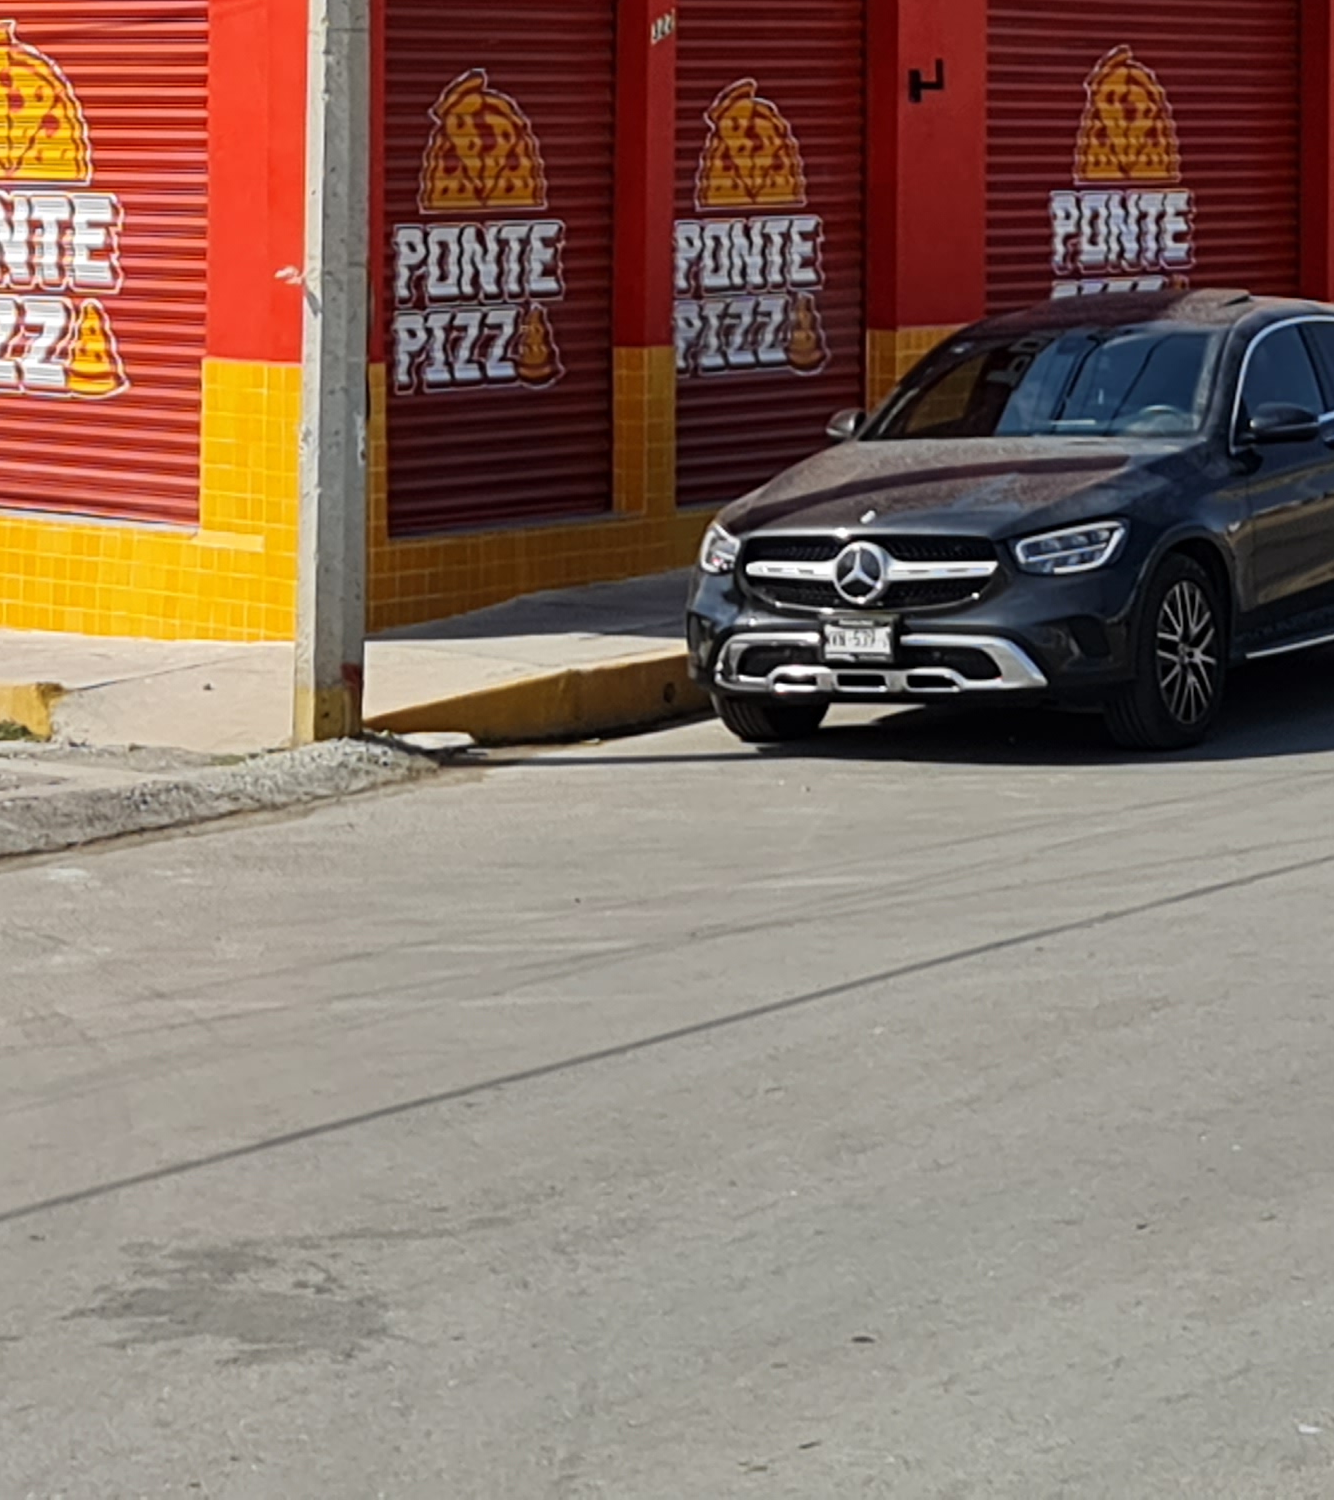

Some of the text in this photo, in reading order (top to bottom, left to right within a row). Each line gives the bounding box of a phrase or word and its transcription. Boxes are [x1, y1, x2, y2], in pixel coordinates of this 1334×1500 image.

[394, 220, 565, 306] PONTE
[675, 217, 825, 294] PONTE
[1050, 190, 1195, 274] PONTE
